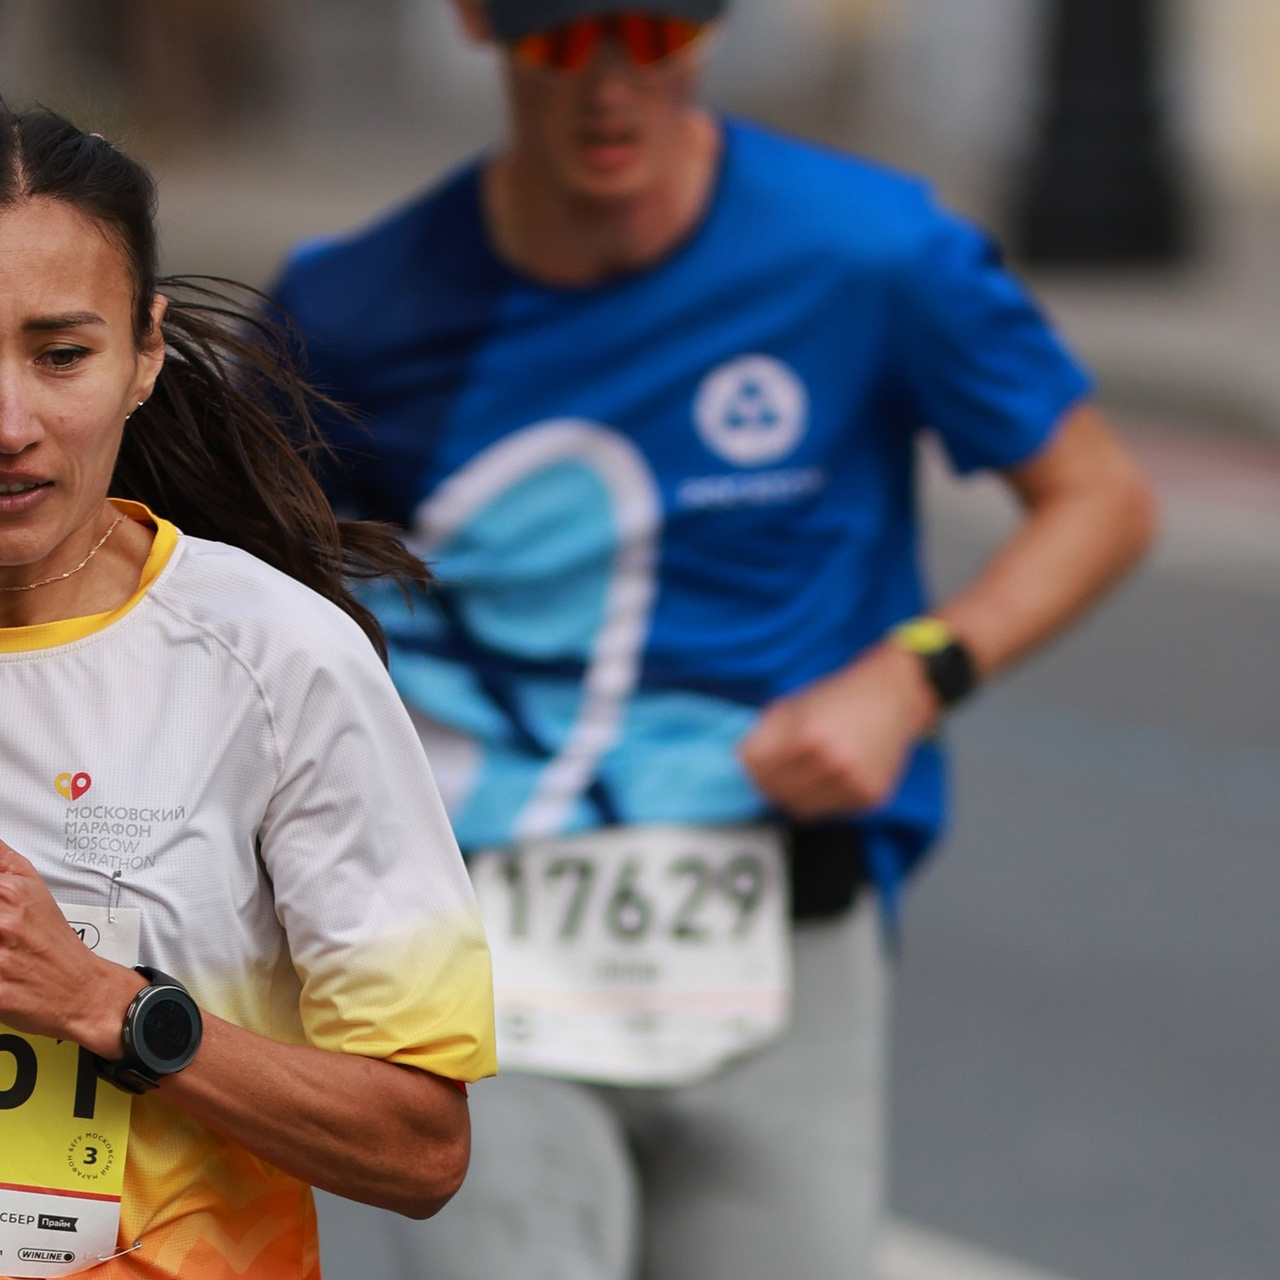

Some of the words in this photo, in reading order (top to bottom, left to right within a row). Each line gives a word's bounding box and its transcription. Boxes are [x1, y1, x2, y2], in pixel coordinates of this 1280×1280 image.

[65, 805, 186, 822] МОСКОВСКИЙ
[64, 821, 152, 838] МАРАФОН
[65, 836, 140, 854] MOSCOW
[63, 852, 157, 870] MARATHON
[498, 854, 767, 940] 17629
[82, 1146, 98, 1165] 3
[0, 1212, 35, 1225] СБЕР
[41, 1217, 71, 1229] Прайм
[22, 1250, 63, 1261] WINLINE
